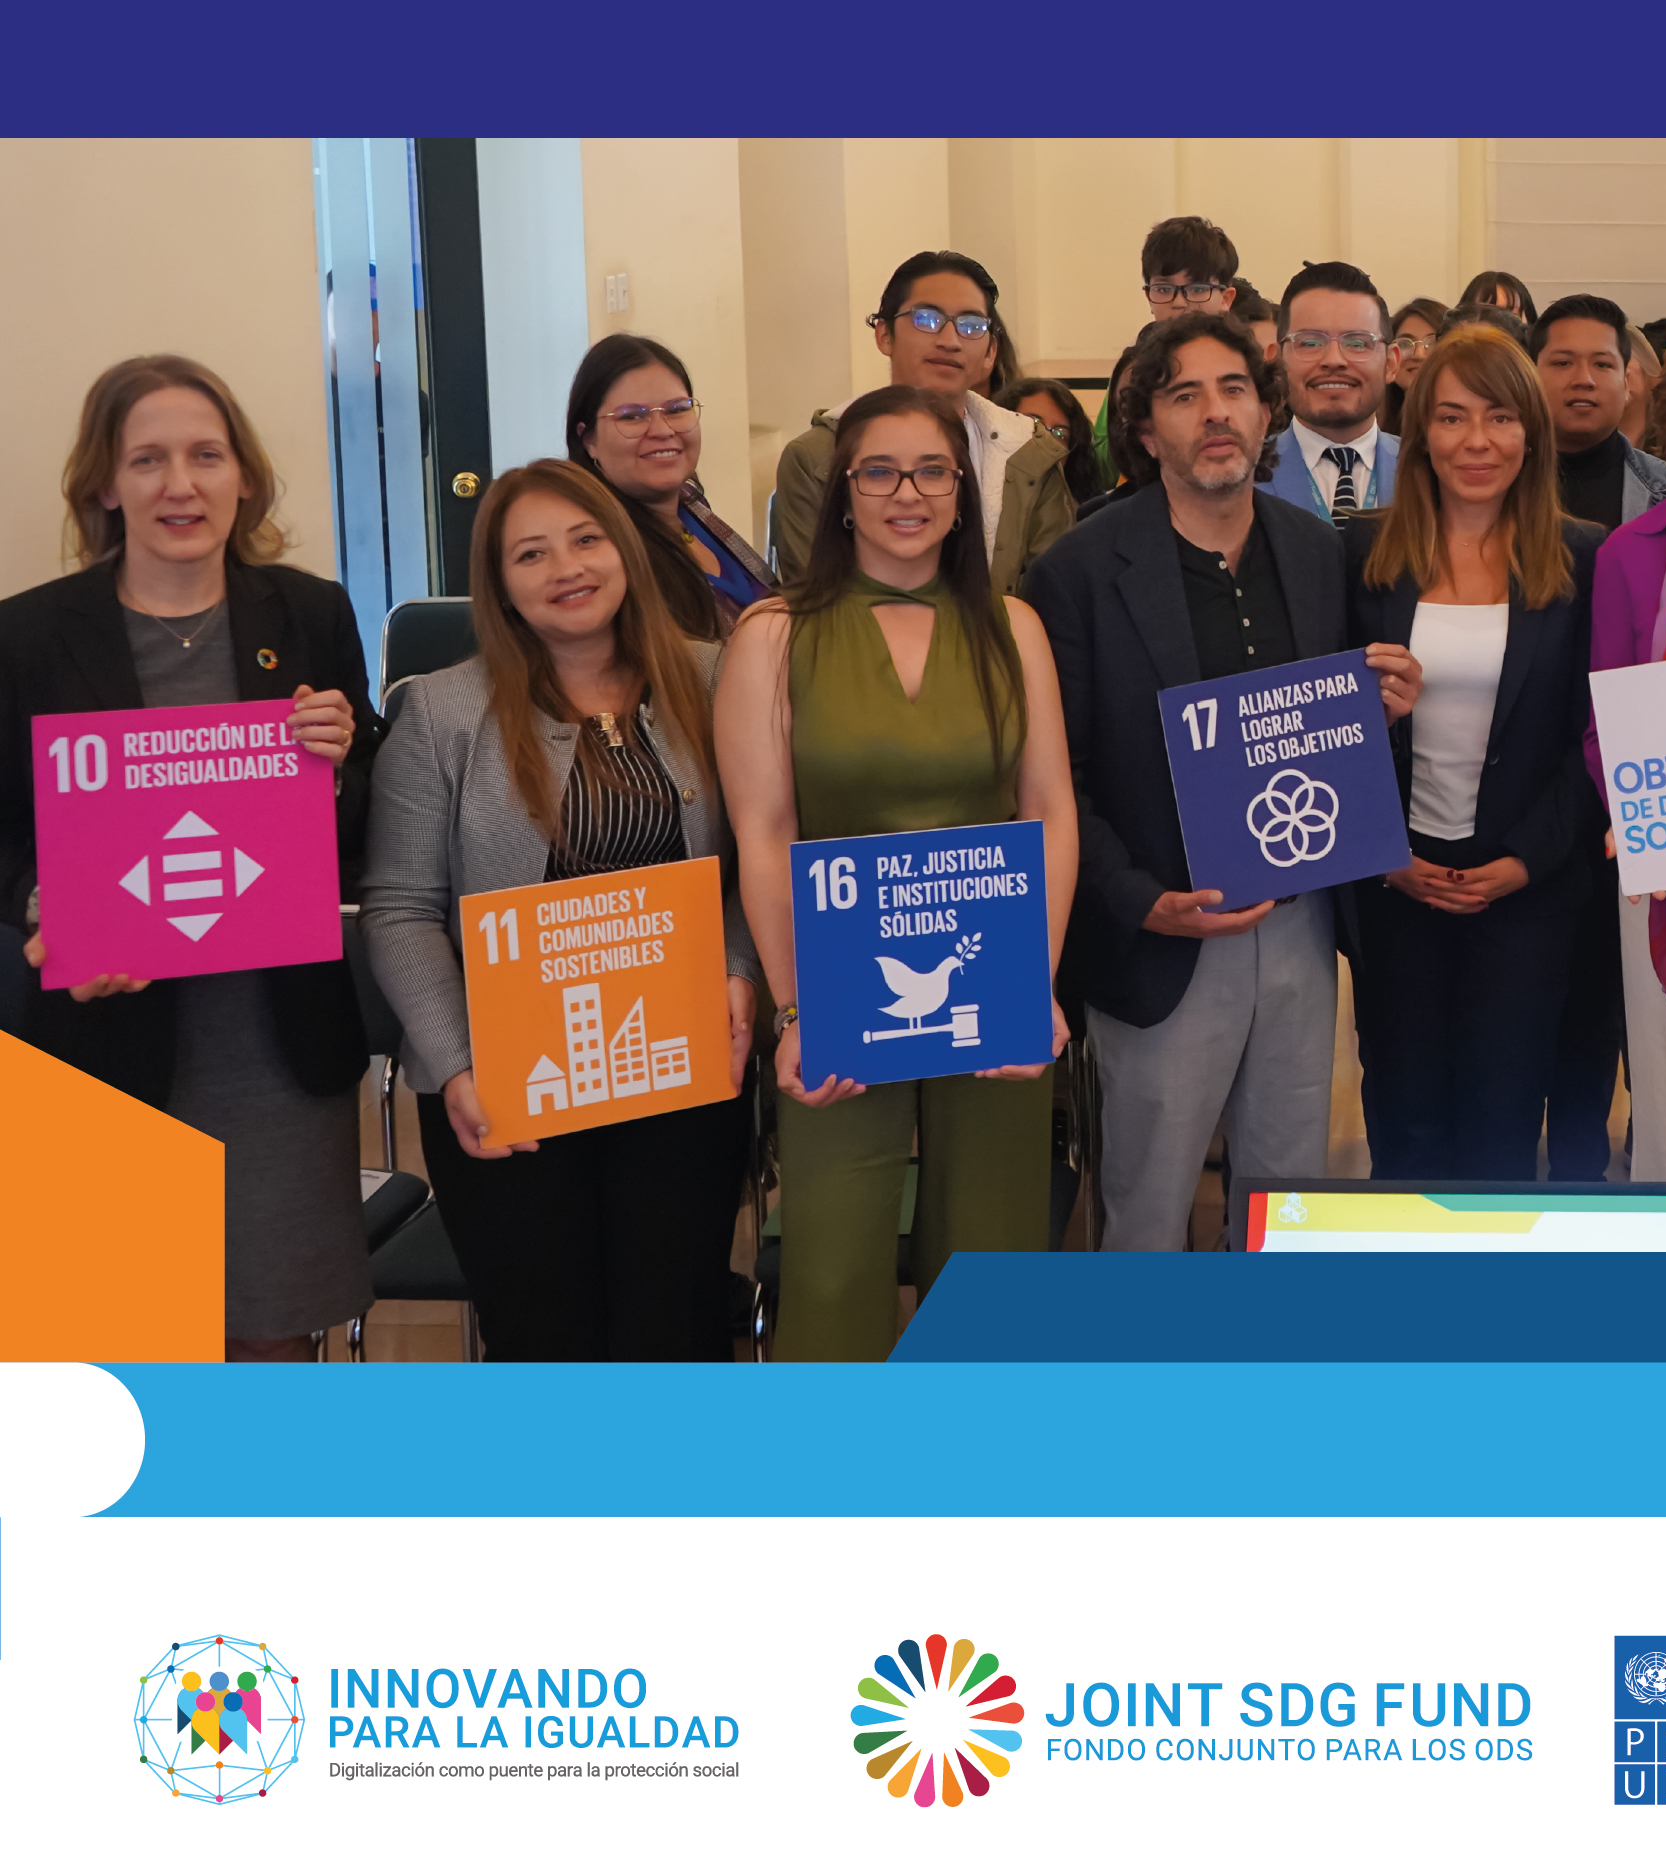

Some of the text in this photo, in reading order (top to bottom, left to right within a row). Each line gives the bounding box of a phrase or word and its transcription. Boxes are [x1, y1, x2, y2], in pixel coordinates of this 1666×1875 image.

[1238, 672, 1359, 717] ALIANZAS PARA
[123, 723, 245, 757] REDUCCIÓN
[249, 723, 275, 748] DE
[1182, 698, 1218, 751] 17
[1240, 710, 1305, 742] LOGRAR
[1245, 723, 1364, 767] LOS OBJETIVOS
[49, 734, 108, 793] 10
[125, 753, 299, 789] DESIGUALDADES
[1620, 798, 1654, 822] DE
[877, 846, 1006, 880] PAZ, JUSTICIA
[809, 856, 858, 912] 16
[878, 873, 1028, 909] E INSTITUCIONES
[537, 887, 646, 926] CIUDADES Y
[880, 909, 957, 938] SÓLIDAS
[478, 908, 520, 965] 11
[539, 910, 674, 954] COMUNIDADES
[541, 939, 664, 983] SOSTENIBLES
